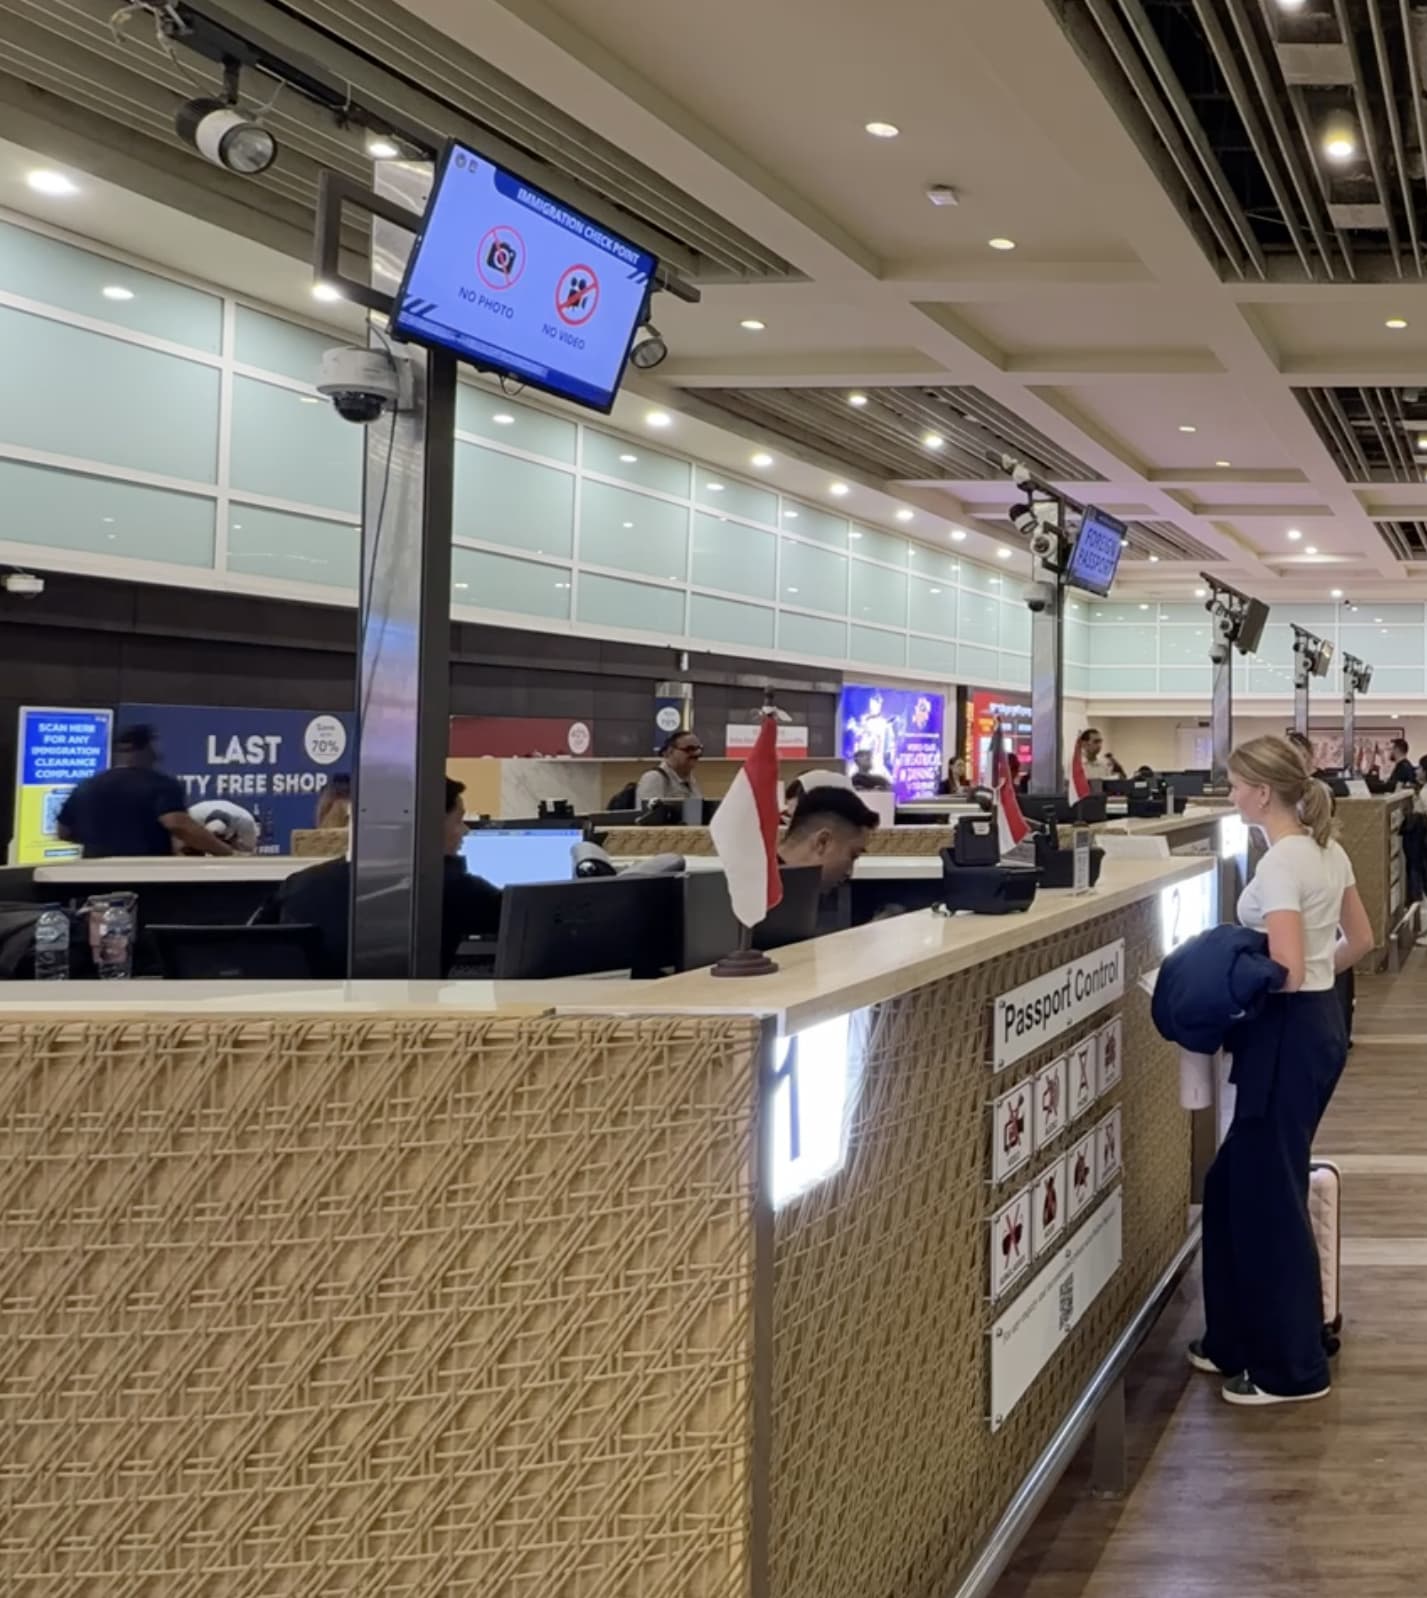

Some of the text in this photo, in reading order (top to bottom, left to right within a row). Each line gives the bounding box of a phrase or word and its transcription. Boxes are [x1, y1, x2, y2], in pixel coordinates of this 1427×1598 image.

[517, 187, 639, 265] IMMIGRATION CHECK POINT
[458, 287, 514, 319] NO PHOTO
[541, 323, 585, 350] NO VIDEO
[38, 723, 68, 733] SCAN
[43, 735, 90, 744] FOR ANY
[207, 735, 282, 765] LAST
[311, 739, 339, 753] 70%
[177, 772, 328, 795] TY FREE SHOP
[1005, 951, 1119, 1043] Passport Control
